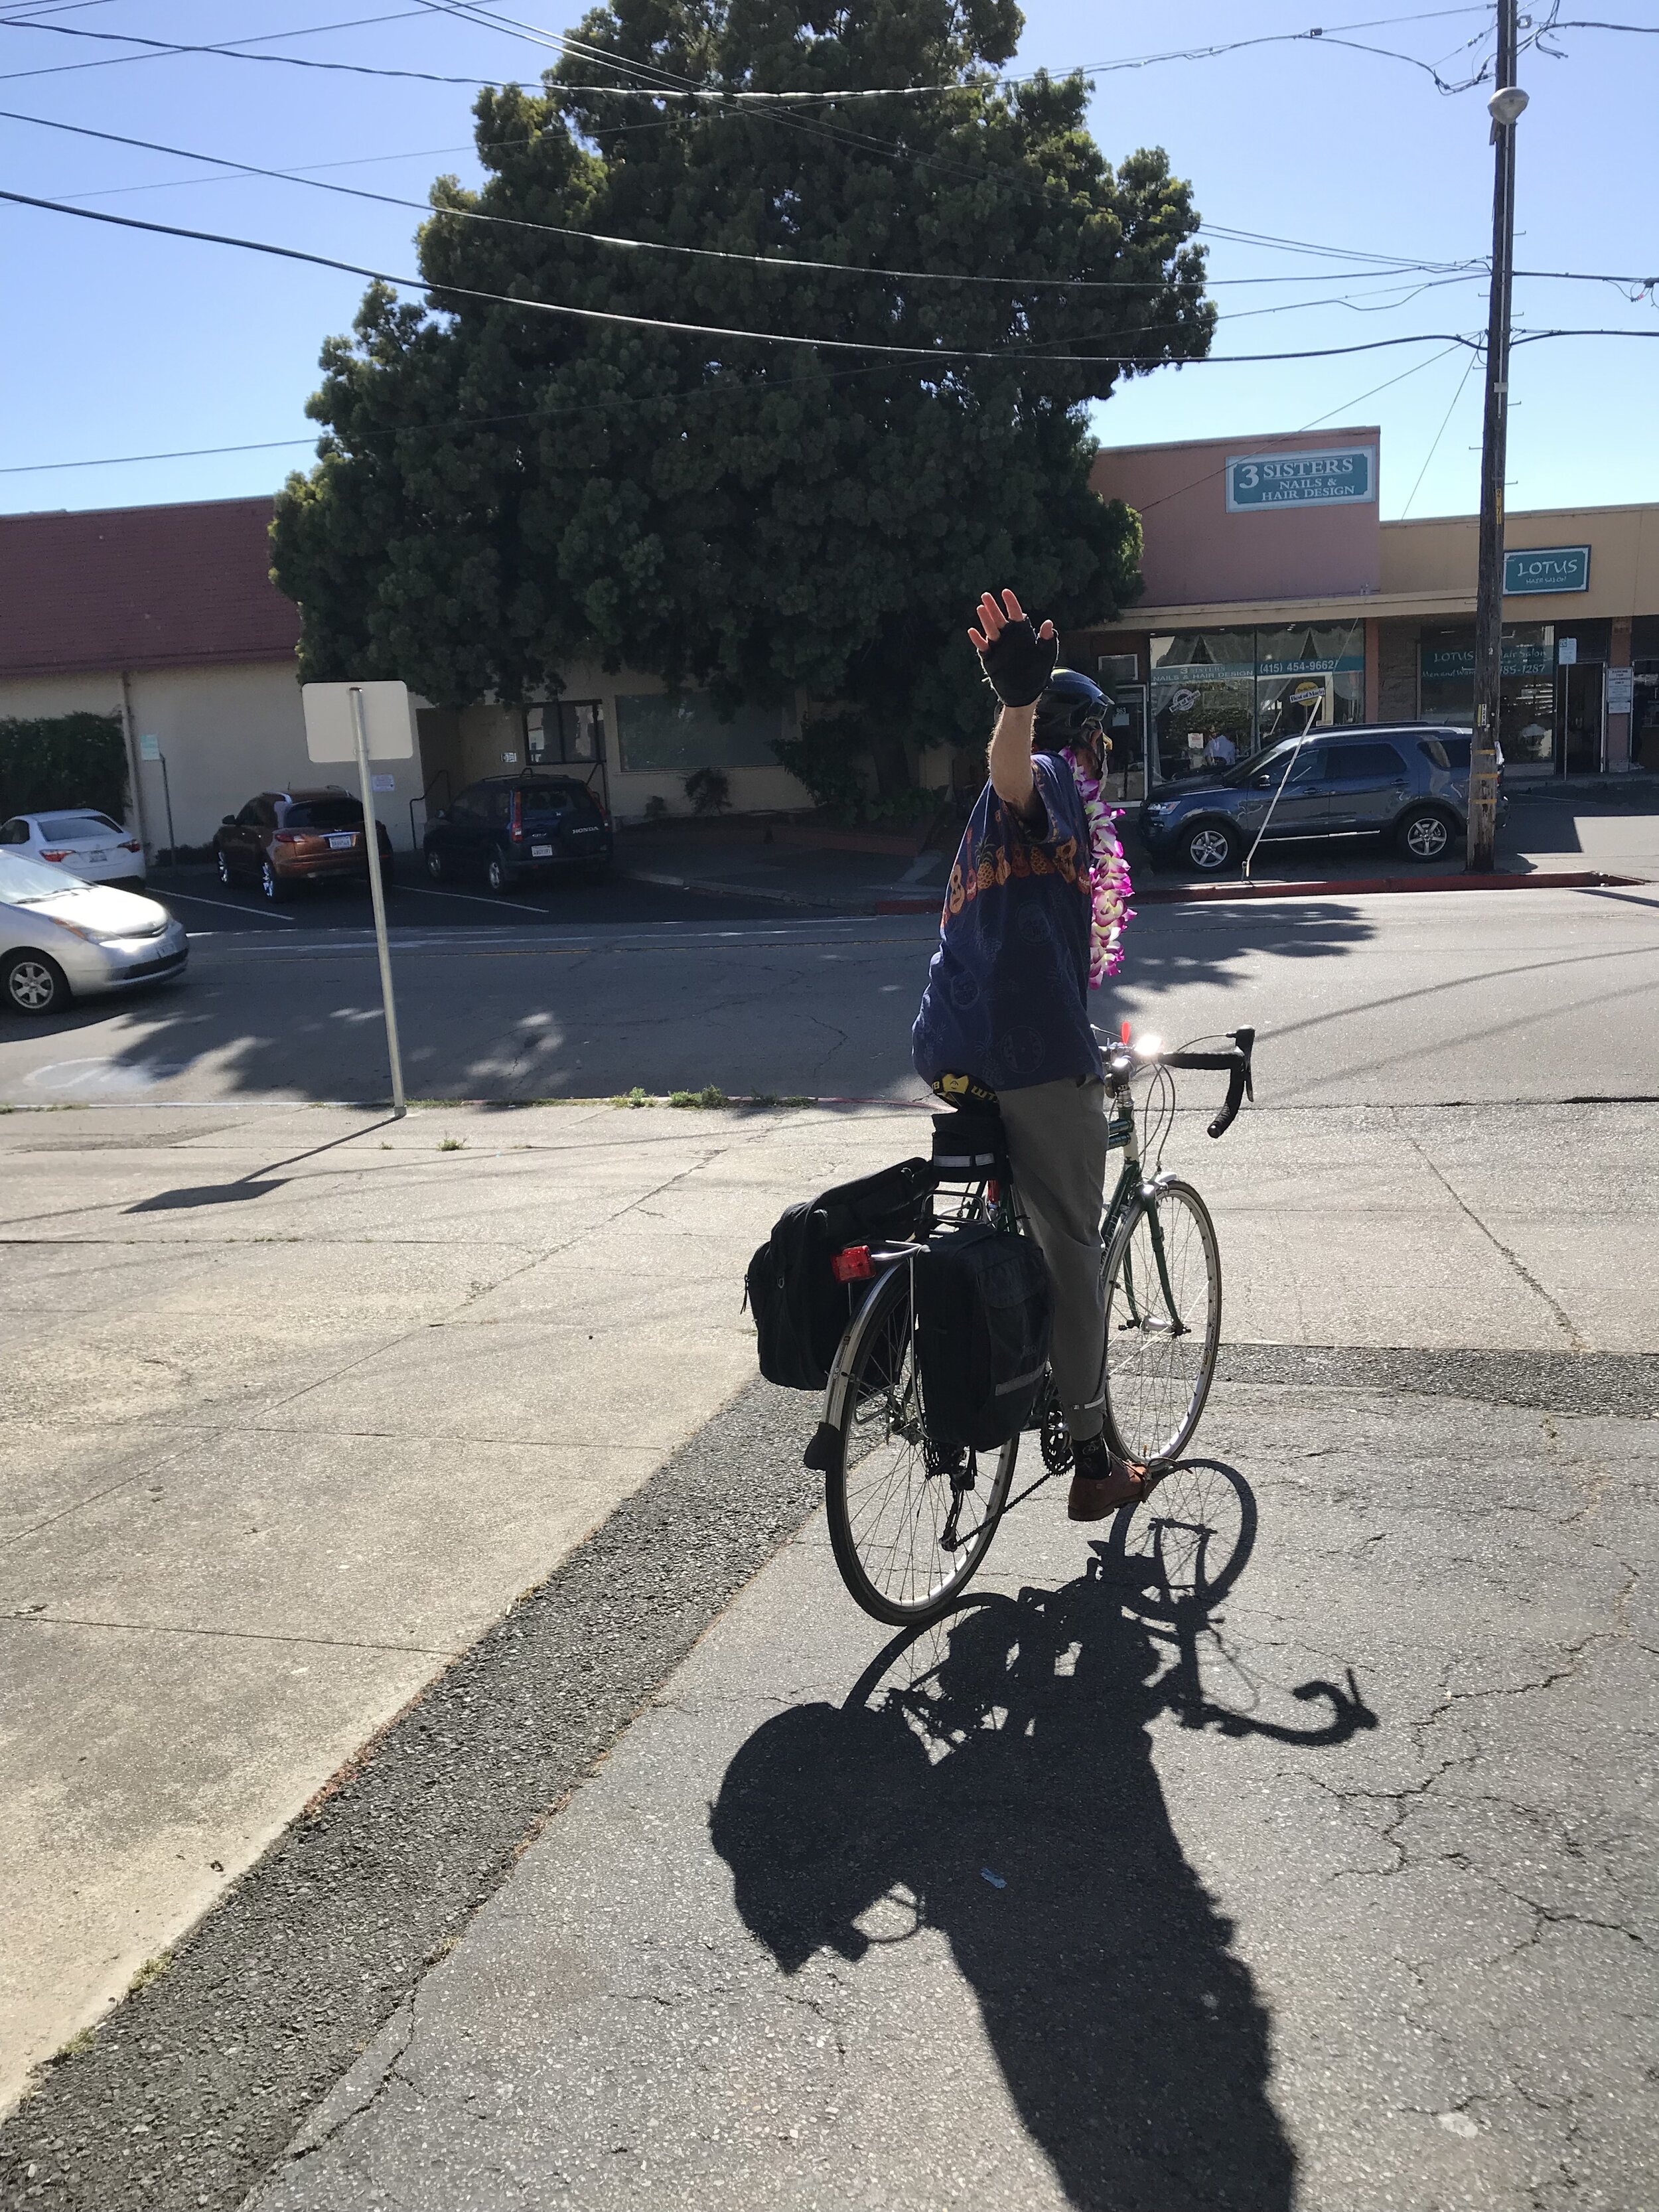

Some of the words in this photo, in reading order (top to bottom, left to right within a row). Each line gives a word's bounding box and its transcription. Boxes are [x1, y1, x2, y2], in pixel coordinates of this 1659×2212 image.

[1239, 465, 1260, 488] 3
[1263, 458, 1354, 479] SISTERS
[1280, 479, 1322, 490] NAILS
[1327, 477, 1337, 486] &
[1262, 490, 1299, 501] HAIR
[1305, 485, 1355, 498] DESIGN
[1518, 559, 1577, 576] LOTUS
[1434, 652, 1475, 662] LOTUS
[1260, 663, 1283, 674] (415)
[1287, 661, 1333, 671] 454-9662
